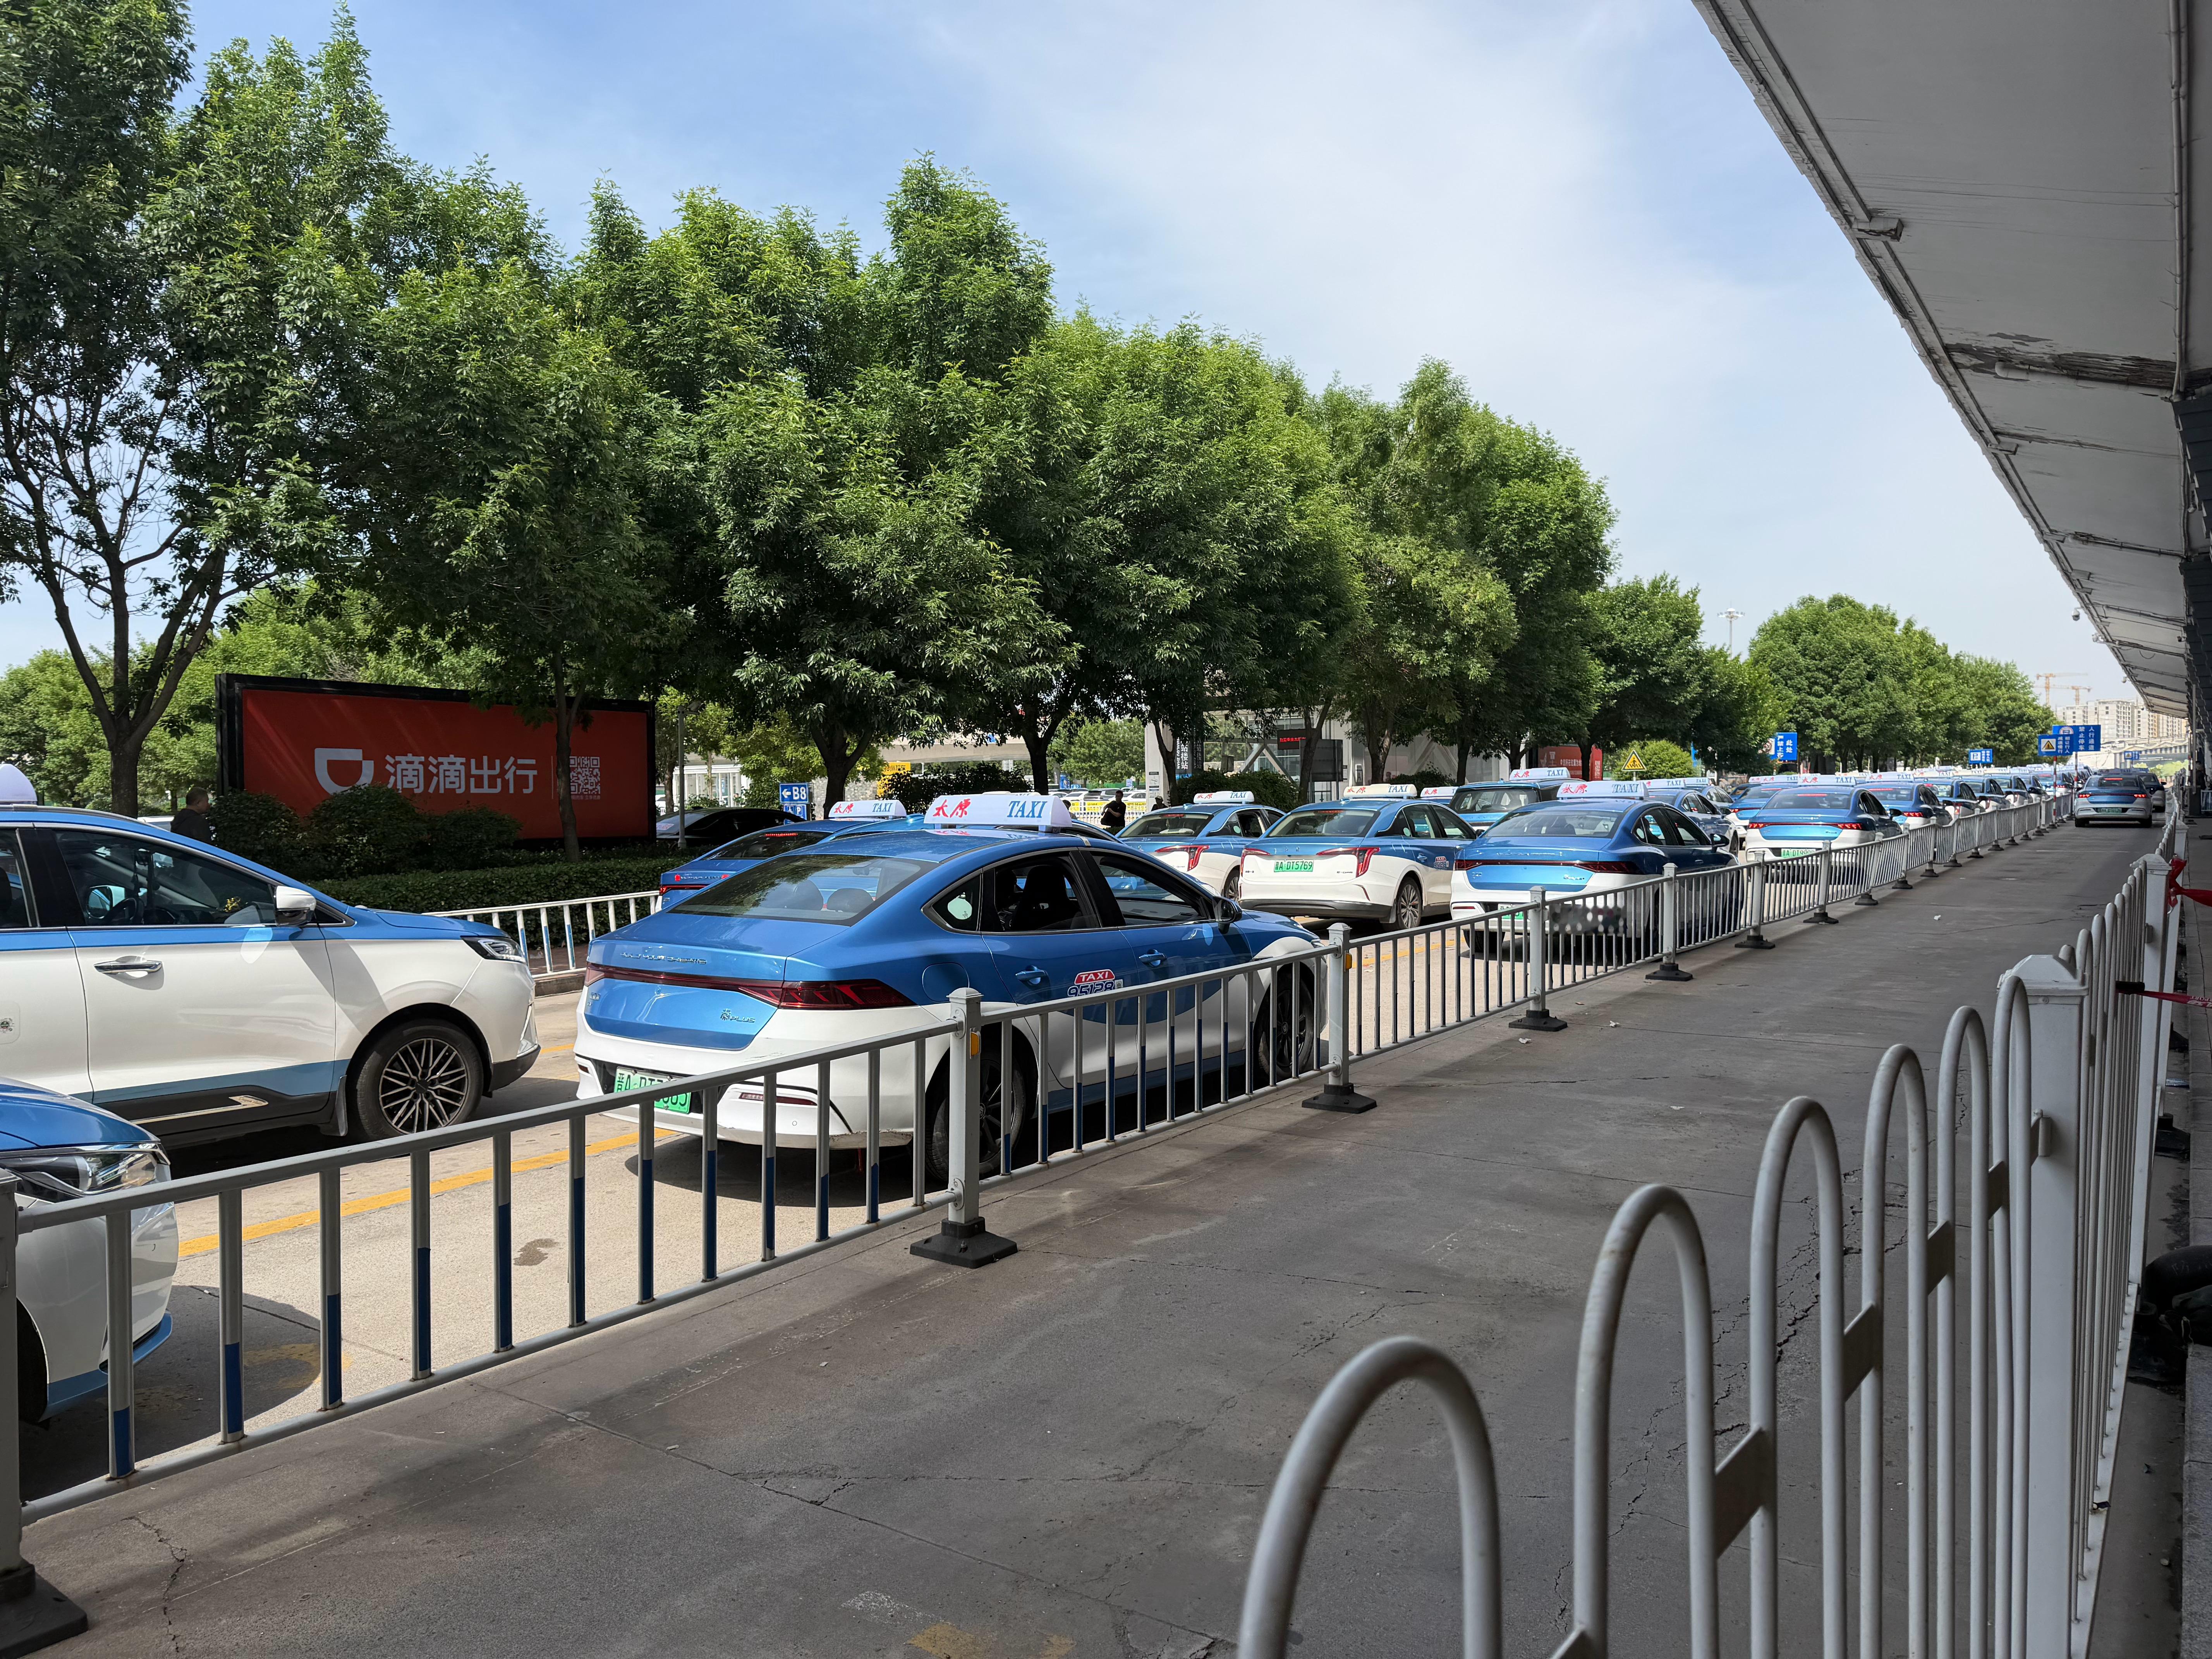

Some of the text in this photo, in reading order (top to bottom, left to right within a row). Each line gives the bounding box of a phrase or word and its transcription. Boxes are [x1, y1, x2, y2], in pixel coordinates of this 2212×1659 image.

[385, 753, 538, 793] 滴滴出行
[793, 787, 806, 800] B8
[1612, 783, 1639, 793] TAXI
[833, 802, 893, 814] 太原 TAXI
[933, 798, 971, 818] 太原
[1007, 801, 1048, 818] TAXI
[1286, 861, 1313, 870] DT5769
[1080, 971, 1109, 982] TAXI
[1067, 981, 1115, 997] 95128
